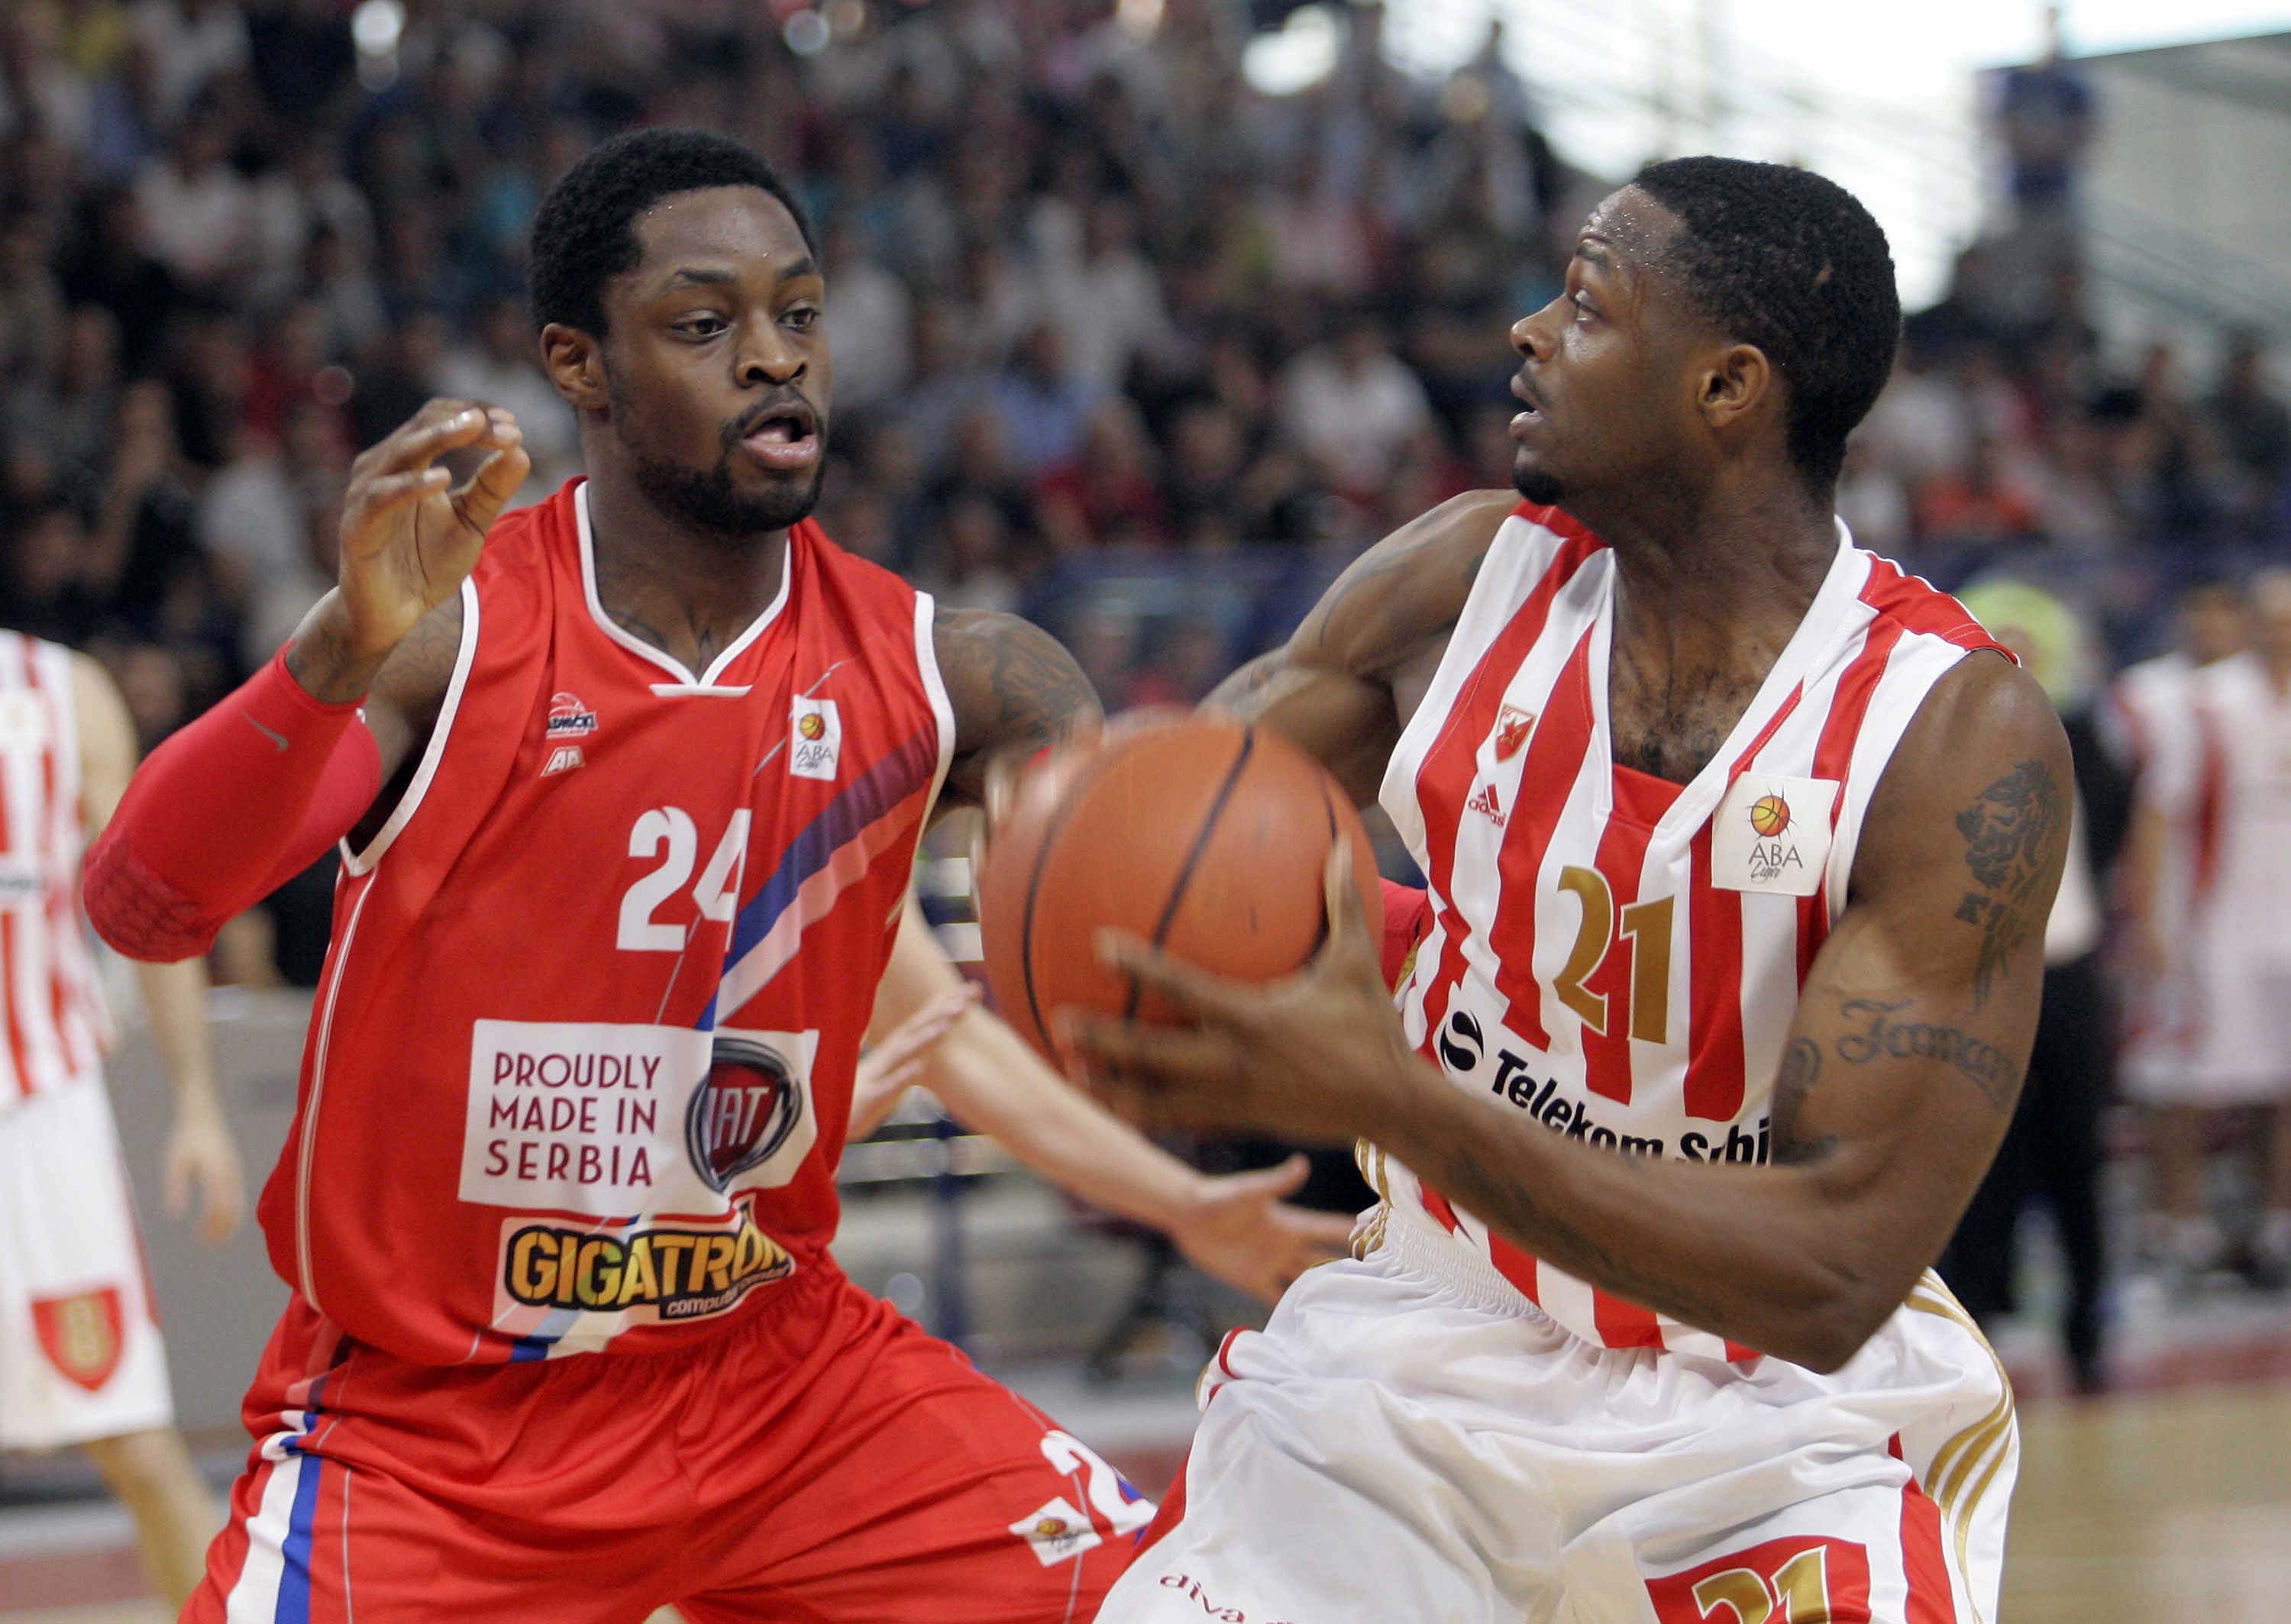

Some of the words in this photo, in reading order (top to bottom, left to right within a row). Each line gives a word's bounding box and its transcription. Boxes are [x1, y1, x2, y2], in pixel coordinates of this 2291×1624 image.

[616, 806, 751, 953] 24
[1748, 842, 1803, 868] ABA
[1553, 866, 1674, 1045] 21
[493, 1052, 661, 1090] PROUDLY
[489, 1095, 598, 1135] MADE
[617, 1098, 658, 1136] IN
[702, 1086, 771, 1156] IAT
[1491, 1048, 1664, 1161] Telekom
[484, 1139, 653, 1187] SERBIA
[1159, 1574, 1245, 1623] diva
